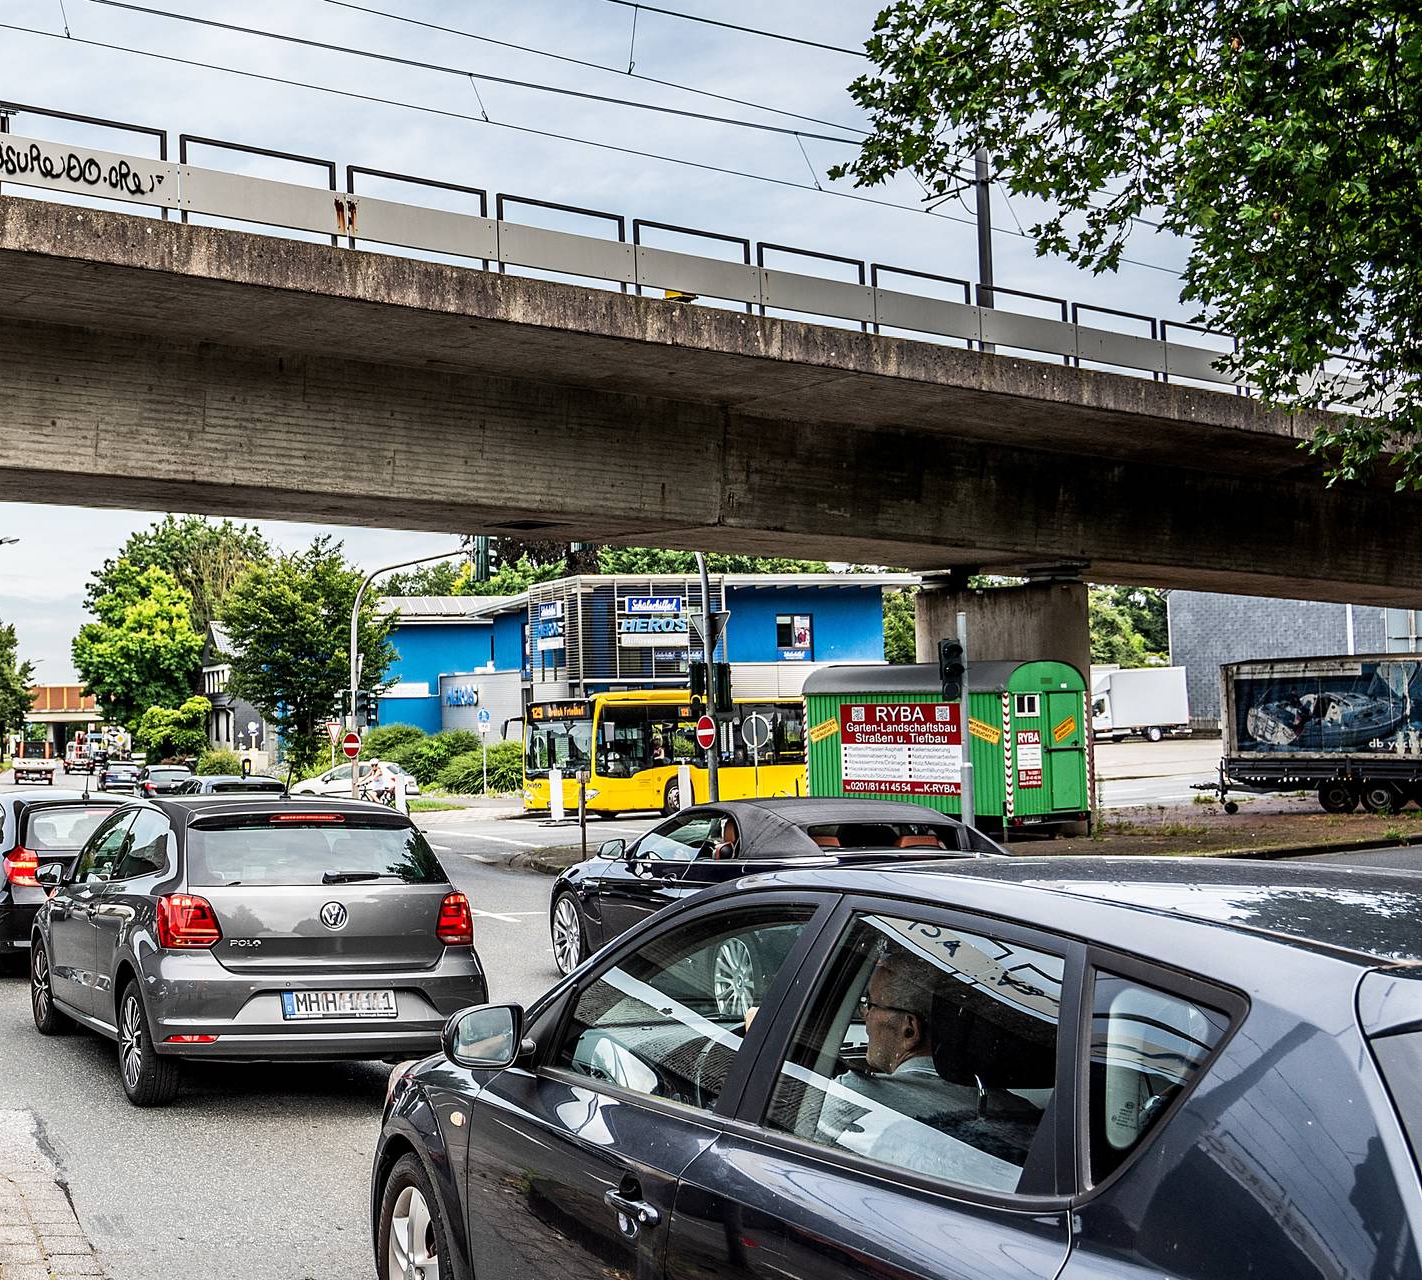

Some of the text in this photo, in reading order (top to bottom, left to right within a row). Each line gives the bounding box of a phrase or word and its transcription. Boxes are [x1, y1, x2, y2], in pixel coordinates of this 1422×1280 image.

[620, 618, 687, 632] HEROS
[875, 706, 925, 722] RYBA
[846, 722, 957, 733] Garten-Landschaftsbau
[855, 733, 948, 743] Straßen u. Tiefbau
[1017, 732, 1040, 744] RYBA
[1368, 738, 1384, 748] db
[880, 782, 891, 791] 41
[891, 783, 901, 792] 45
[901, 783, 911, 792] 54
[229, 939, 262, 947] POLO
